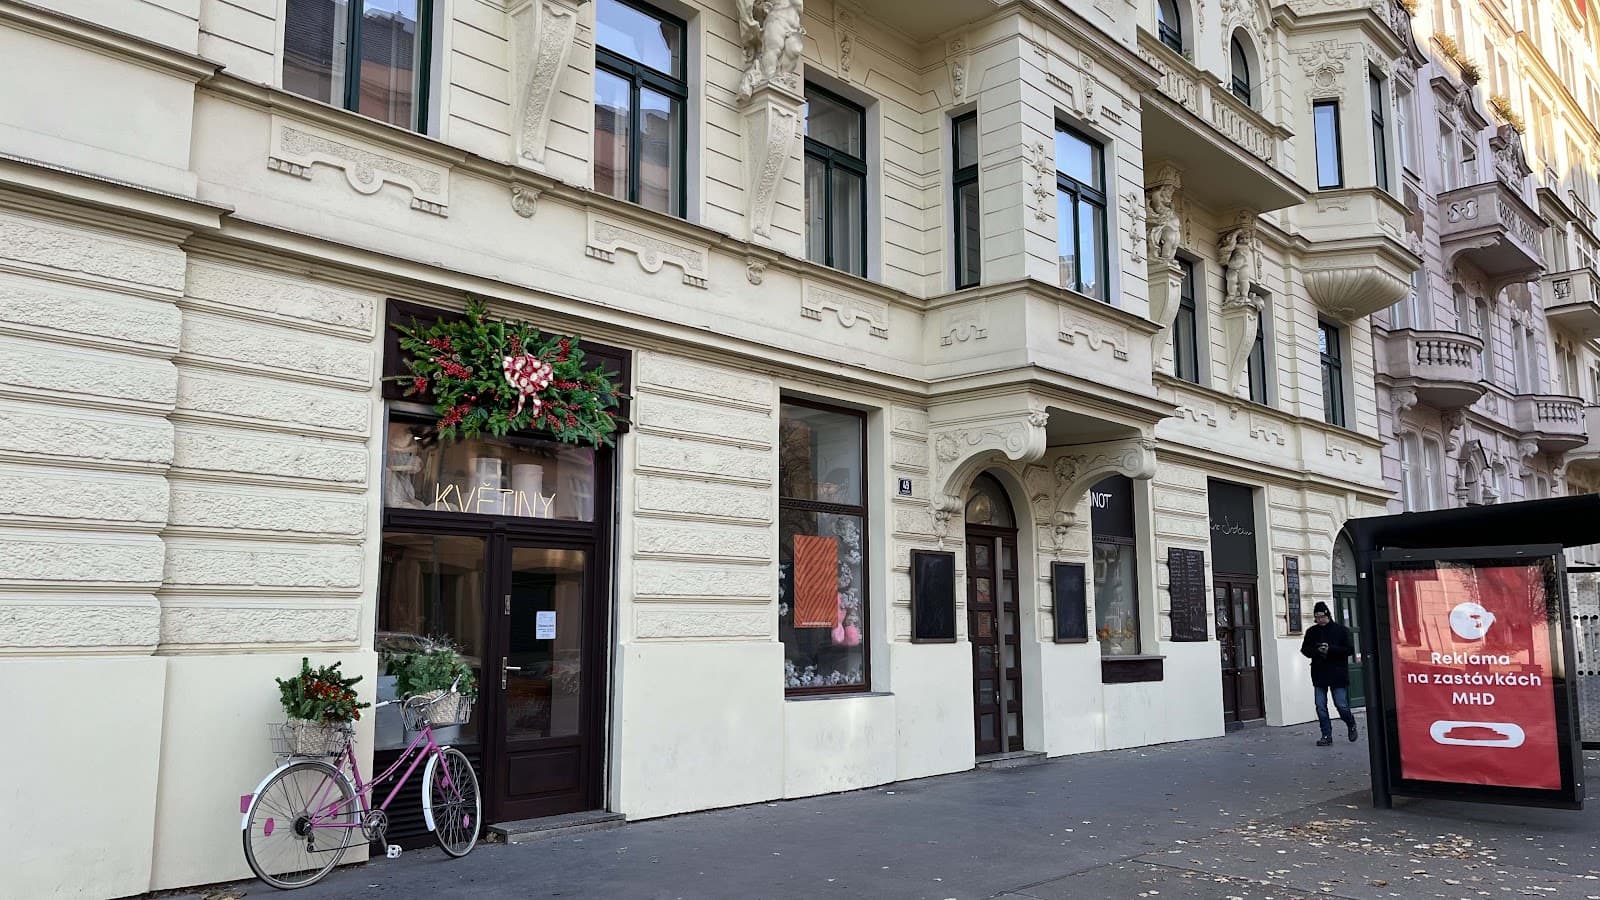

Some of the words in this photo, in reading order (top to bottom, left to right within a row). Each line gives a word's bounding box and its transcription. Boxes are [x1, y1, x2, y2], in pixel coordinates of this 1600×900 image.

[435, 482, 556, 518] KVĚTINY
[1090, 492, 1113, 509] NOT
[1431, 652, 1510, 665] Reklama
[1407, 673, 1429, 684] na
[1433, 672, 1542, 686] zastávkách
[1452, 692, 1495, 706] MHD
